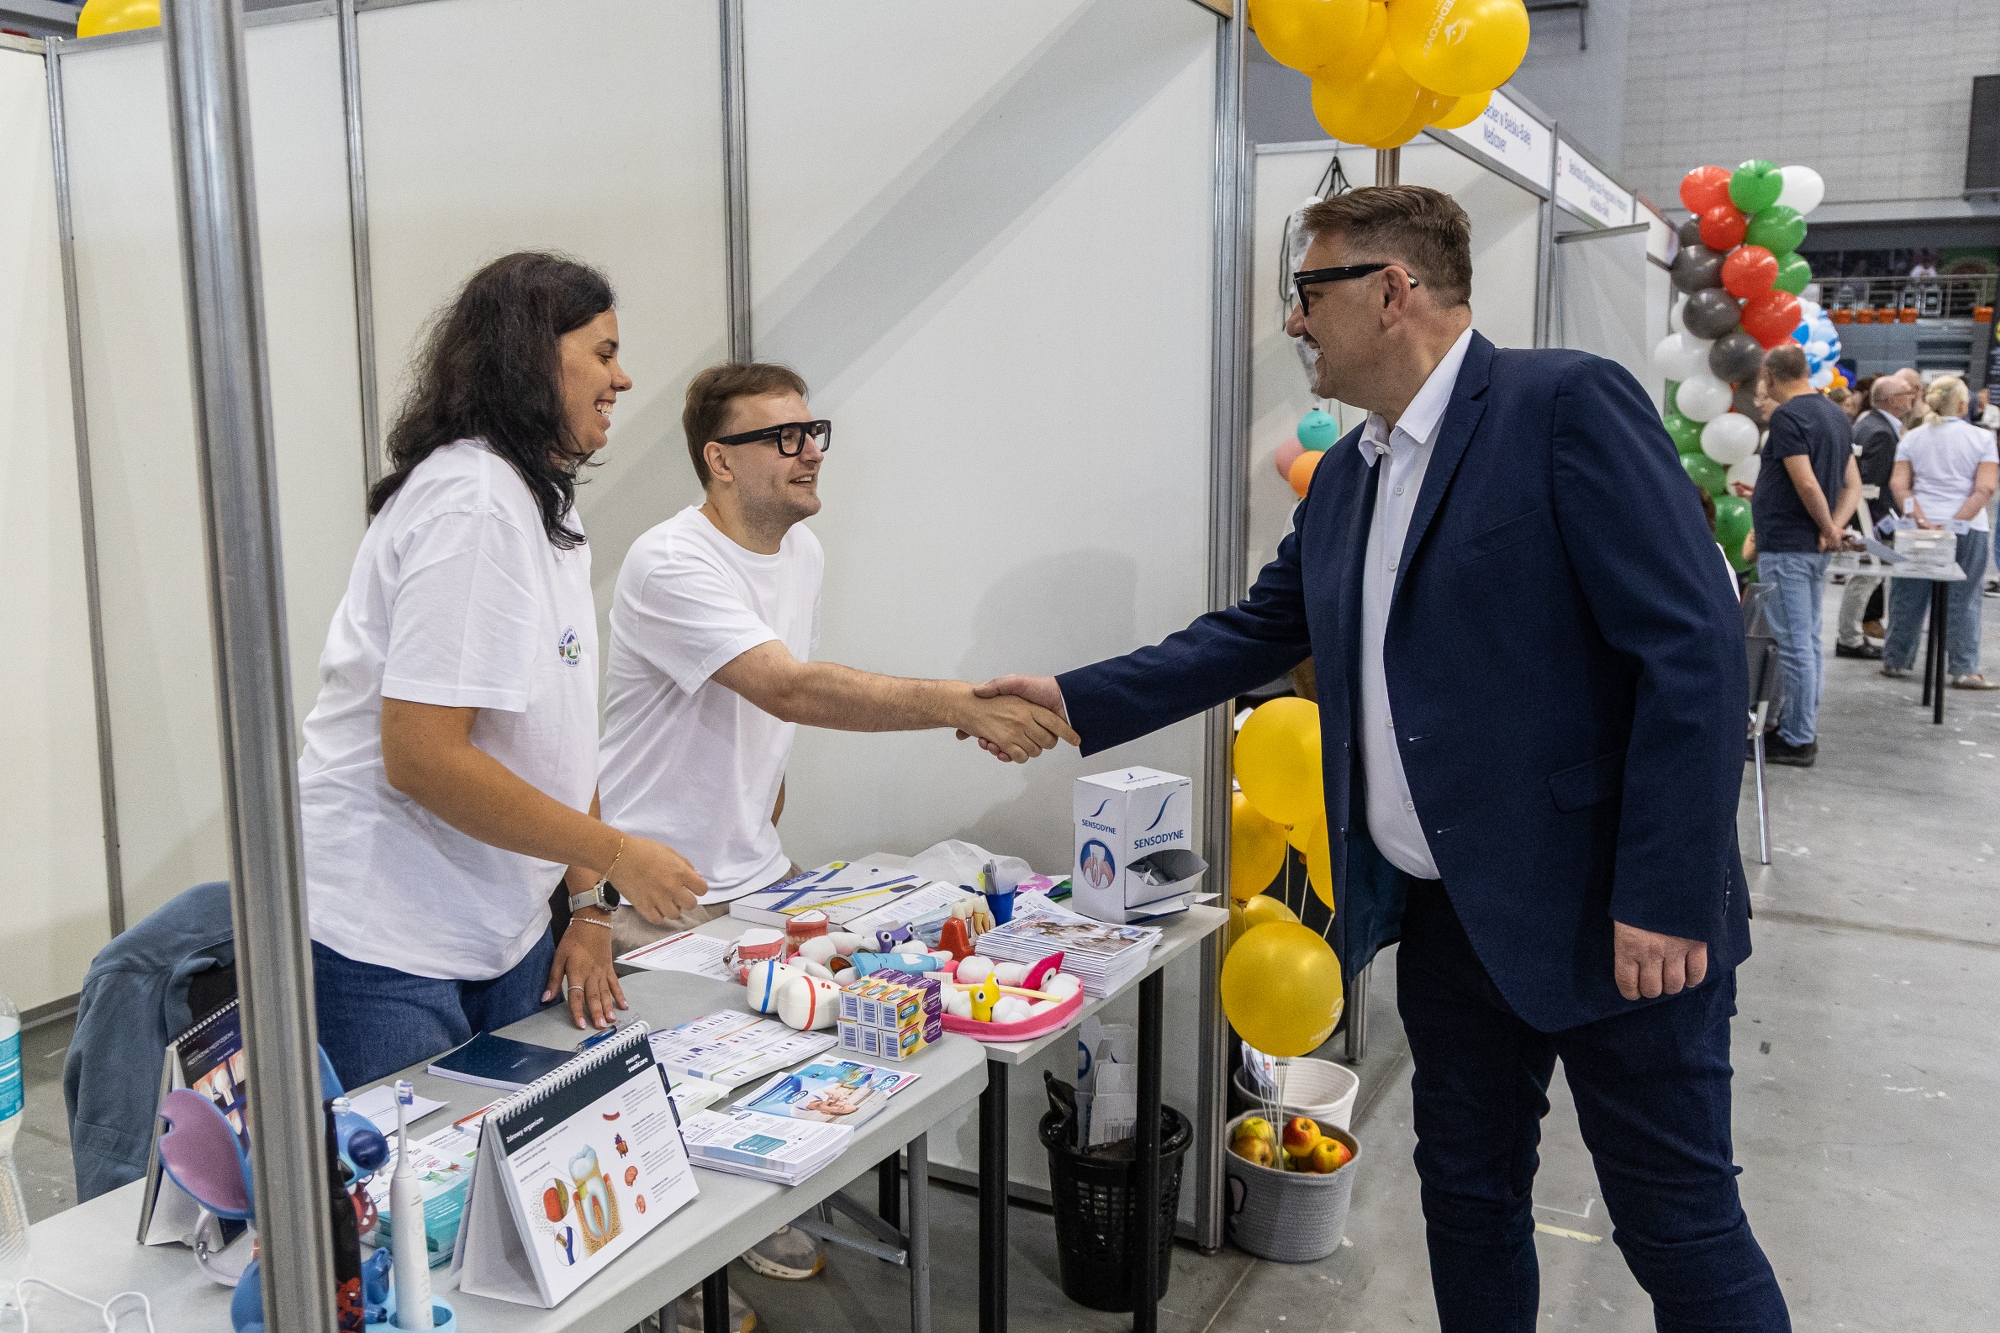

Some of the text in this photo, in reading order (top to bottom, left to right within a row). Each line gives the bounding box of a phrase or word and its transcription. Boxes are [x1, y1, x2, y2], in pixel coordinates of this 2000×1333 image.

[1081, 818, 1117, 835] SENSODYNE
[1133, 829, 1185, 850] SENSODYNE
[627, 1057, 649, 1074] sonicare
